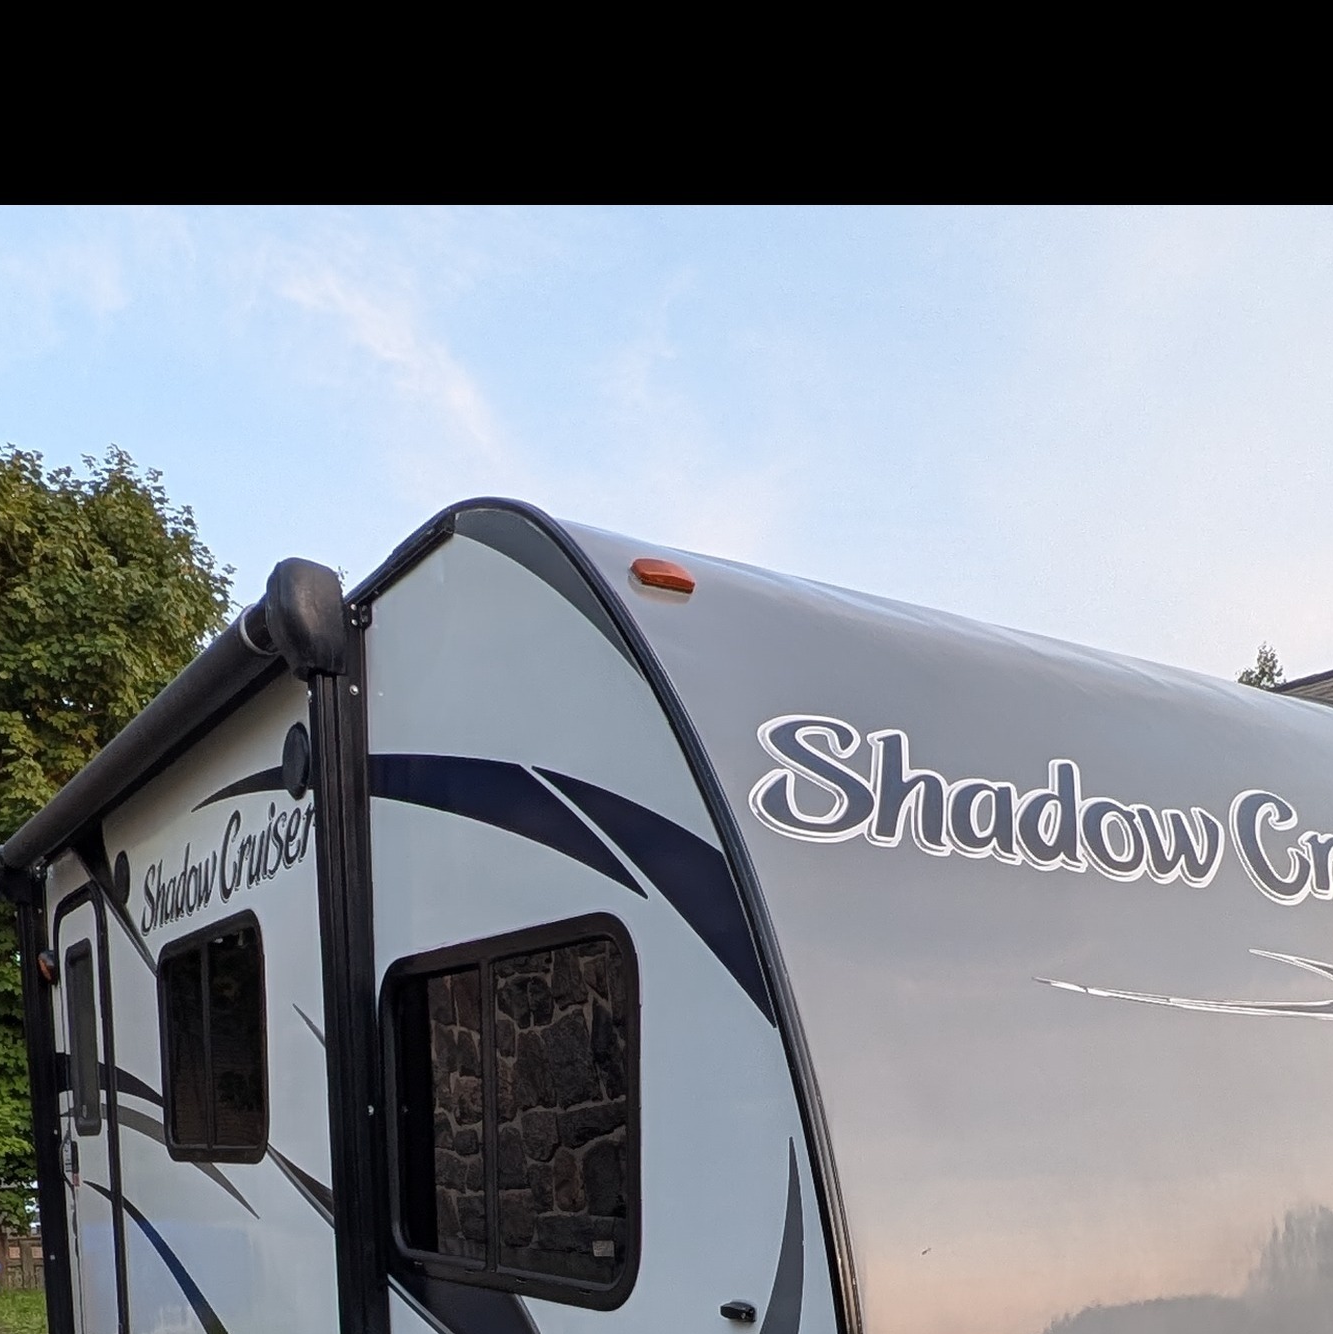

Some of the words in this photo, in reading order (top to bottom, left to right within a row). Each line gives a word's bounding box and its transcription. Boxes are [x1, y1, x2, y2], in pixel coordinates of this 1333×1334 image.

[141, 842, 217, 936] Shadow
[219, 802, 316, 904] Cruiser
[748, 713, 1225, 888] Shadow
